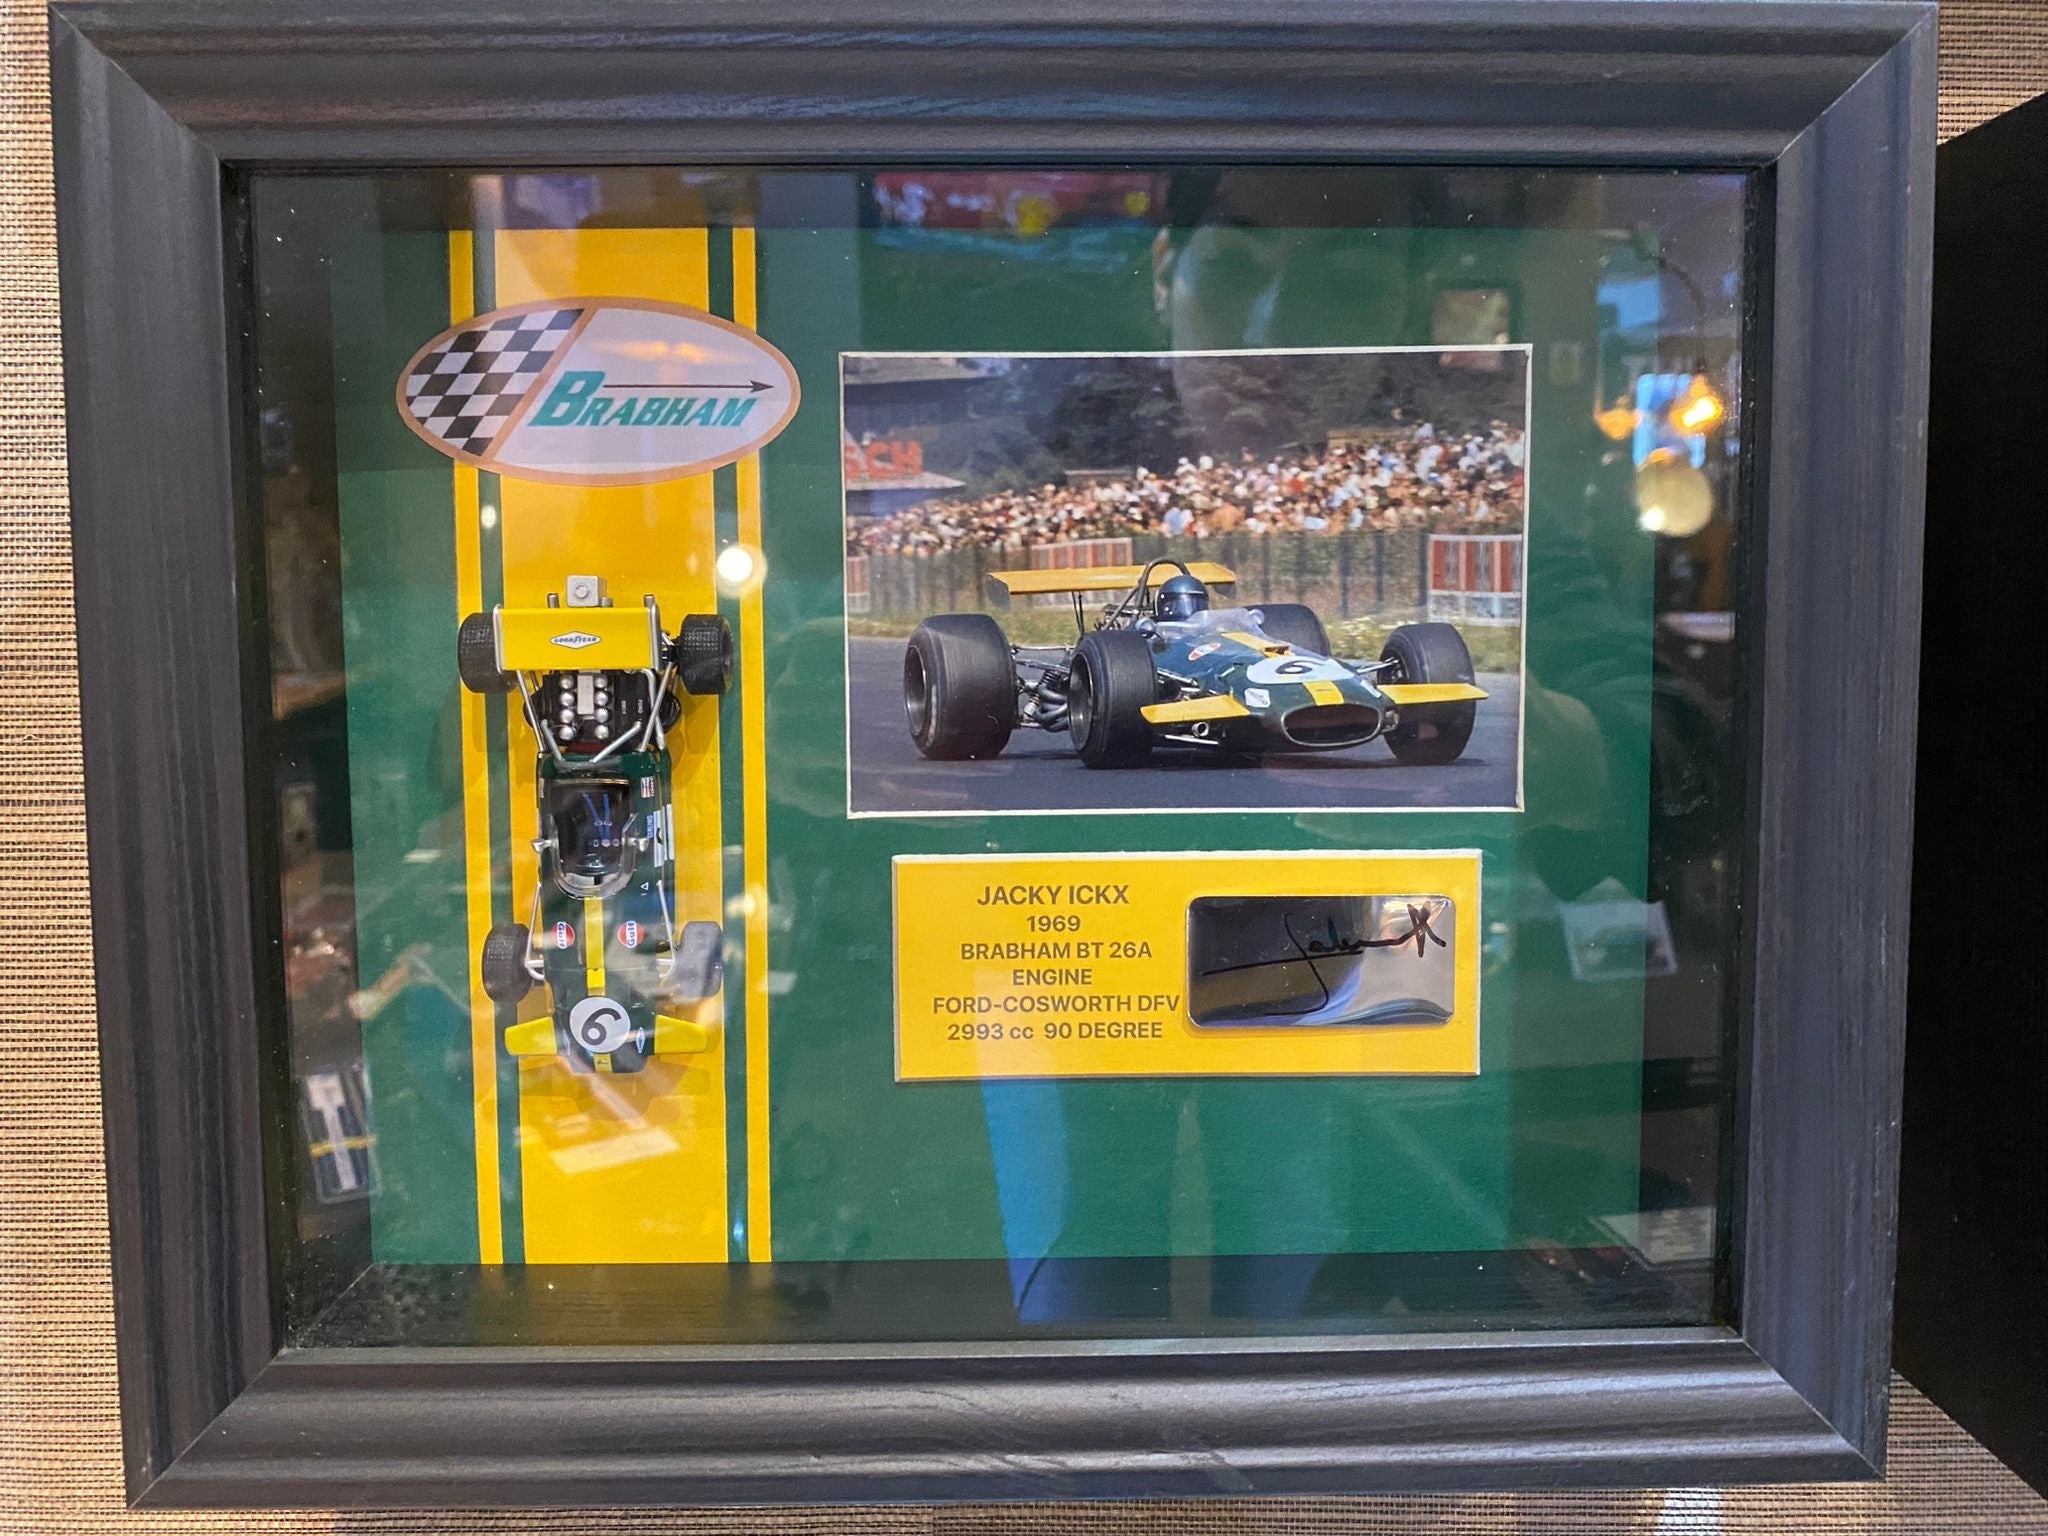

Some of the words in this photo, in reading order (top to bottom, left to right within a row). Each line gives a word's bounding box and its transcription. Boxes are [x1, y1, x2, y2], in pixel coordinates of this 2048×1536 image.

[529, 371, 757, 427] BRABHAM
[1274, 660, 1324, 675] 6
[976, 885, 1063, 906] JACKY
[1069, 884, 1130, 905] ICKX
[1026, 915, 1081, 933] 1969
[960, 942, 1071, 960] BRABHAM
[1076, 941, 1105, 959] BT
[1109, 941, 1153, 959] 26A
[1012, 968, 1093, 986] ENGINE
[933, 995, 1131, 1014] FORD-COSWORTH
[1137, 994, 1180, 1012] DFV
[581, 1007, 622, 1046] 6
[947, 1022, 1004, 1041] 2993
[1009, 1026, 1034, 1040] cc
[1044, 1022, 1073, 1040] 90
[1078, 1021, 1163, 1039] DEGREE
